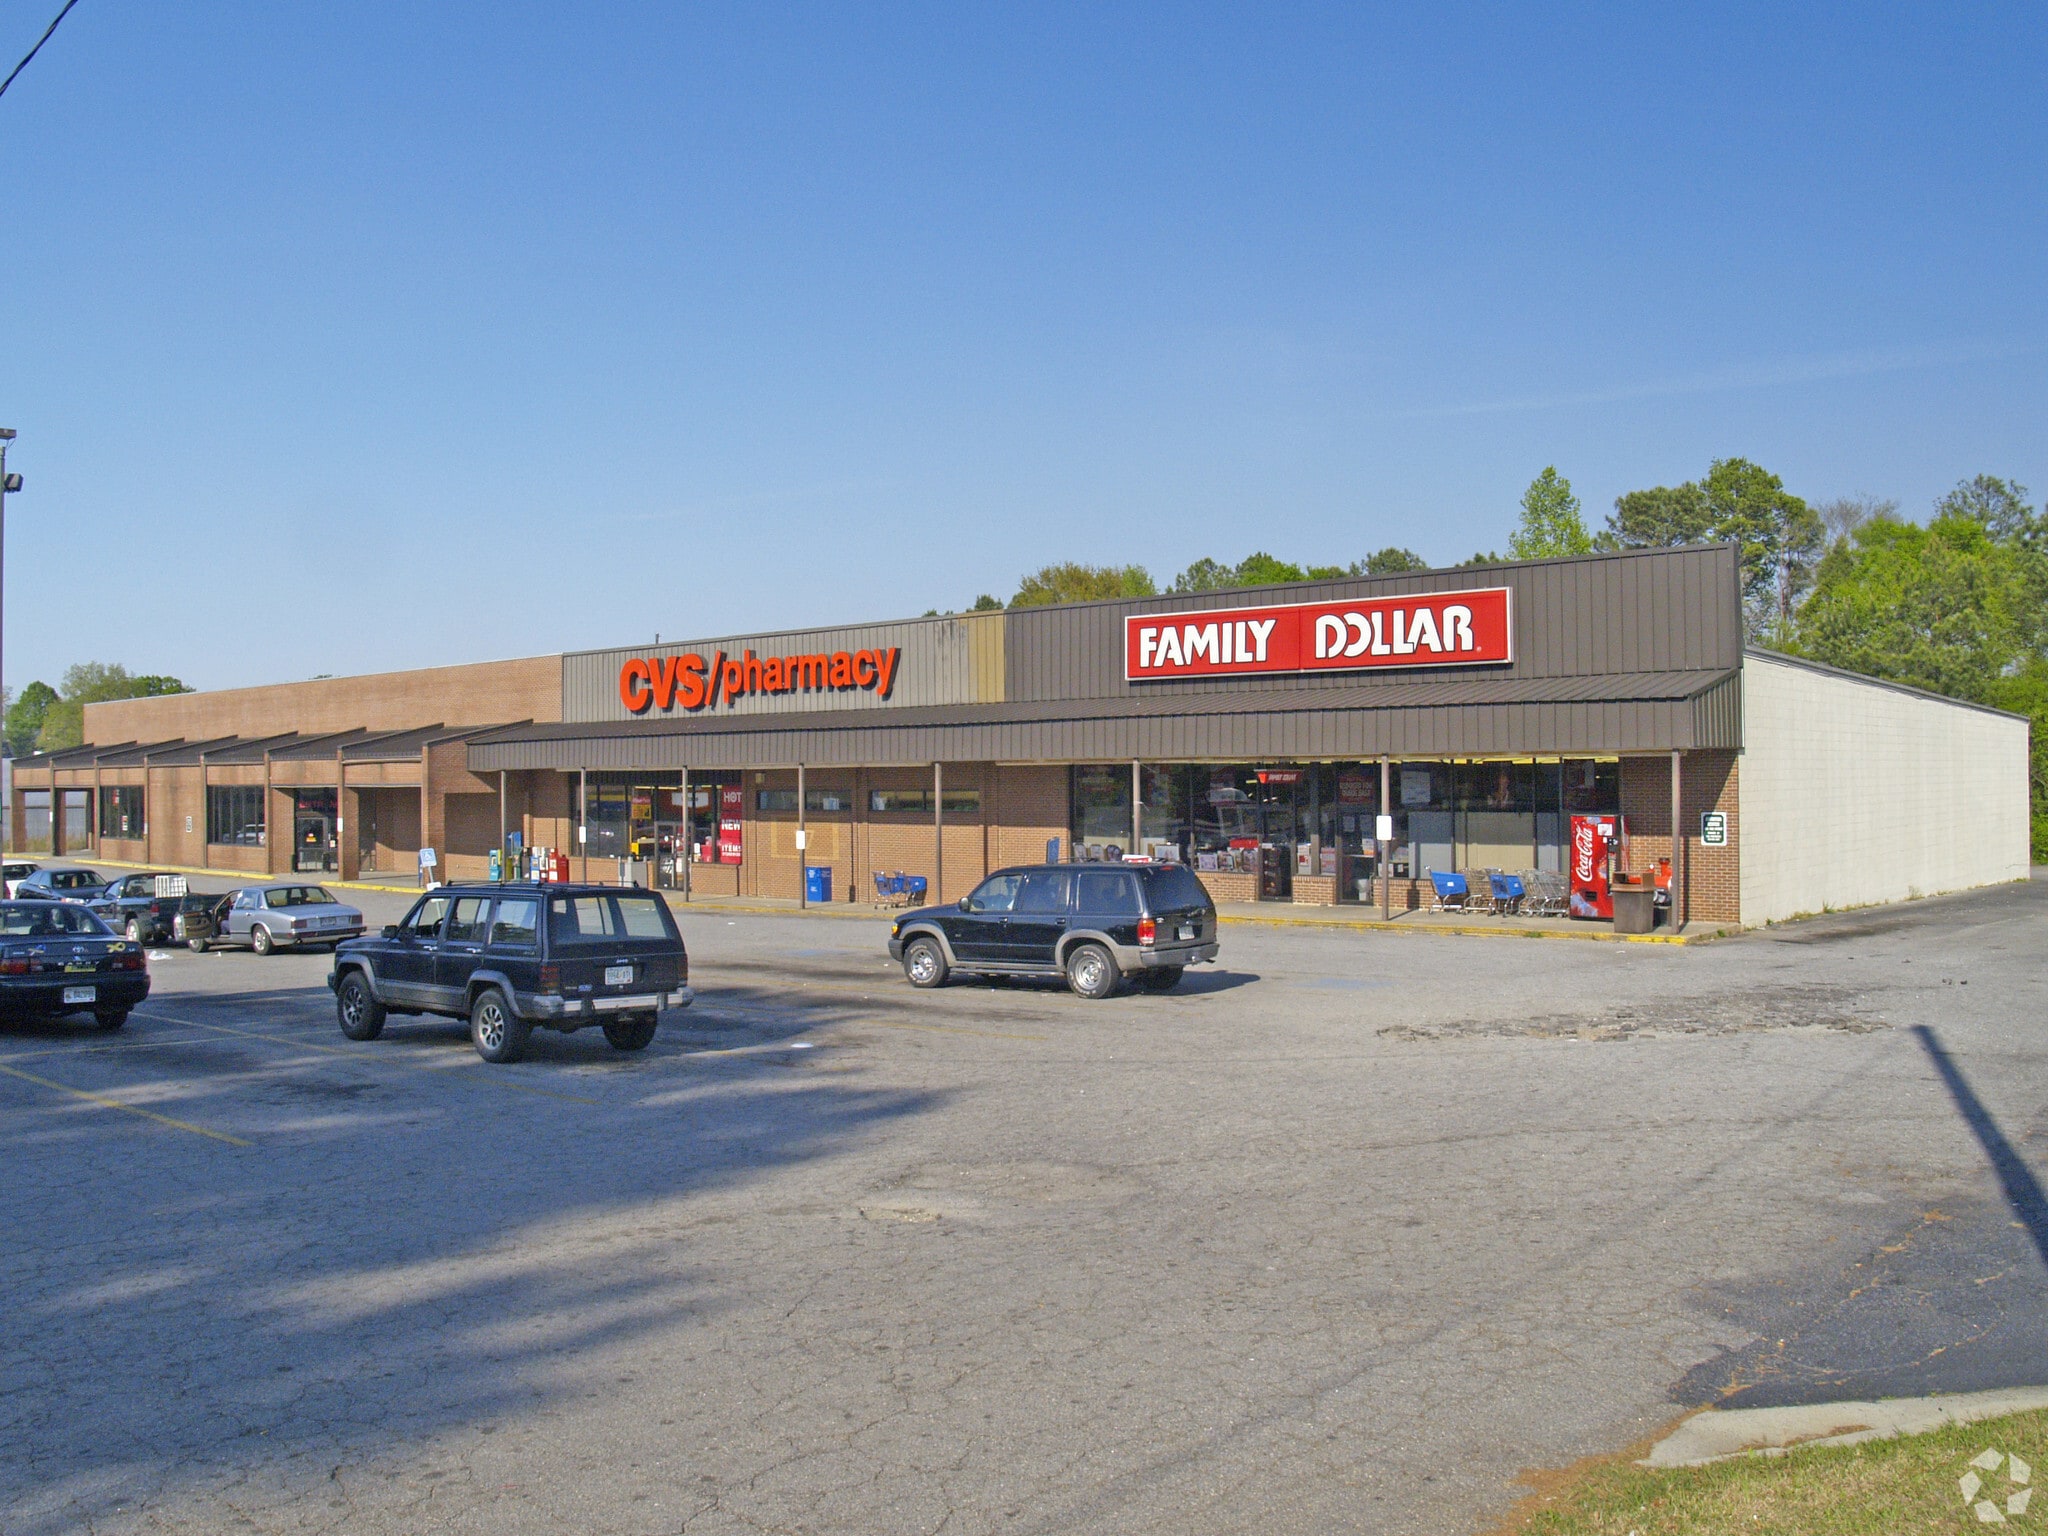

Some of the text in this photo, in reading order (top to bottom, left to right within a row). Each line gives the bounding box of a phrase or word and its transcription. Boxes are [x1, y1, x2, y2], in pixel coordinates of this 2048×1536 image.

[1139, 604, 1475, 668] FAMILY DOLLAR
[723, 791, 742, 803] HOT
